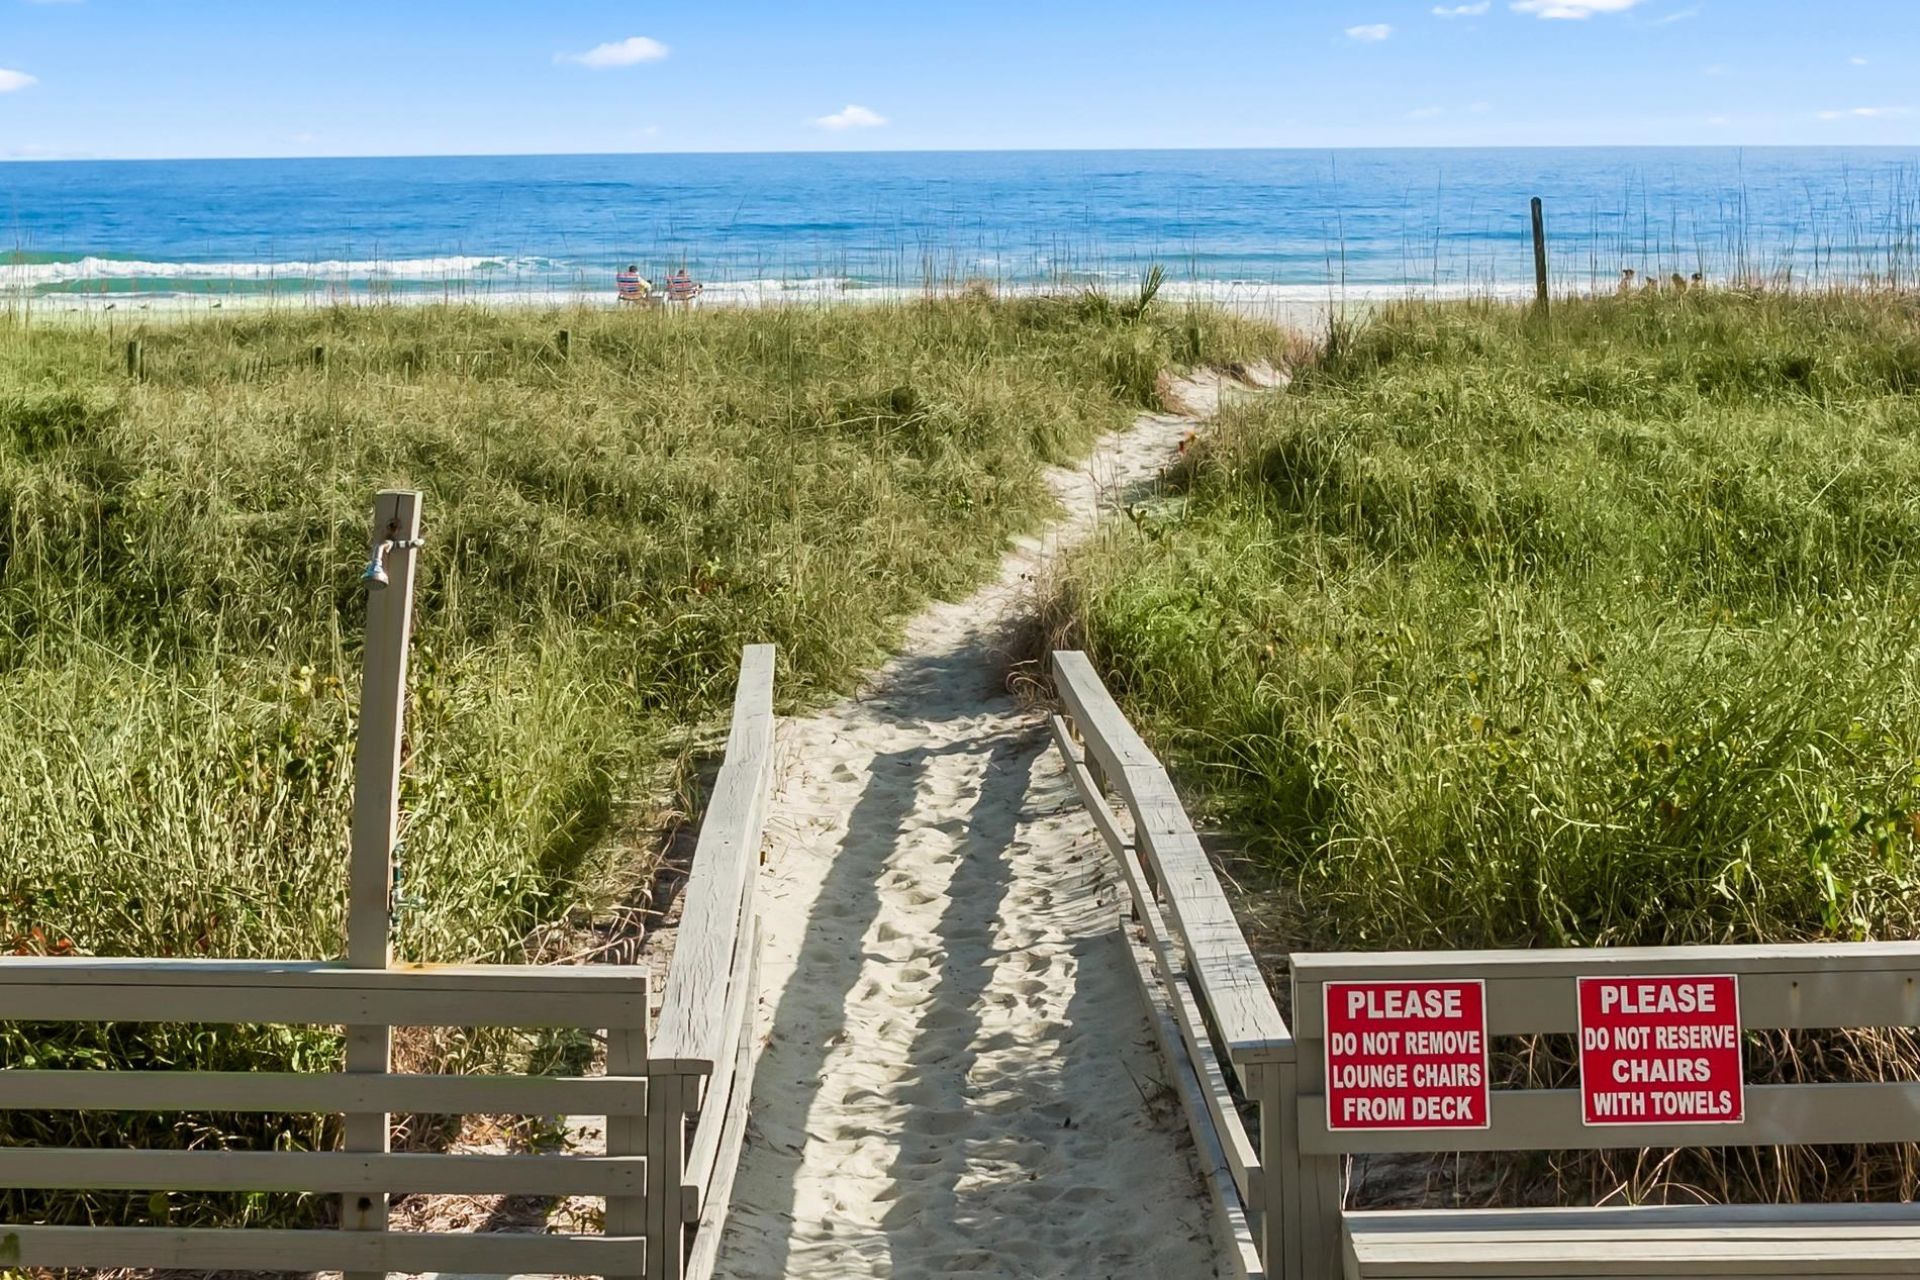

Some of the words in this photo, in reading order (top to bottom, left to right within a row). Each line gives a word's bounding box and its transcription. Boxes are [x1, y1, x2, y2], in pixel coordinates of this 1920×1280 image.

[1347, 990, 1462, 1019] PLEASE
[1601, 984, 1716, 1014] PLEASE
[1332, 1032, 1357, 1056] DO
[1362, 1031, 1400, 1055] NOT
[1405, 1030, 1480, 1055] REMOVE
[1584, 1027, 1610, 1051] DO
[1614, 1026, 1651, 1050] NOT
[1655, 1025, 1735, 1049] RESERVE
[1333, 1064, 1408, 1089] LOUNGE
[1413, 1063, 1481, 1088] CHAIRS
[1612, 1058, 1711, 1083] CHAIRS
[1343, 1097, 1405, 1121] FROM
[1412, 1096, 1473, 1120] DECK
[1593, 1091, 1645, 1116] WITH
[1650, 1090, 1732, 1115] TOWELS
